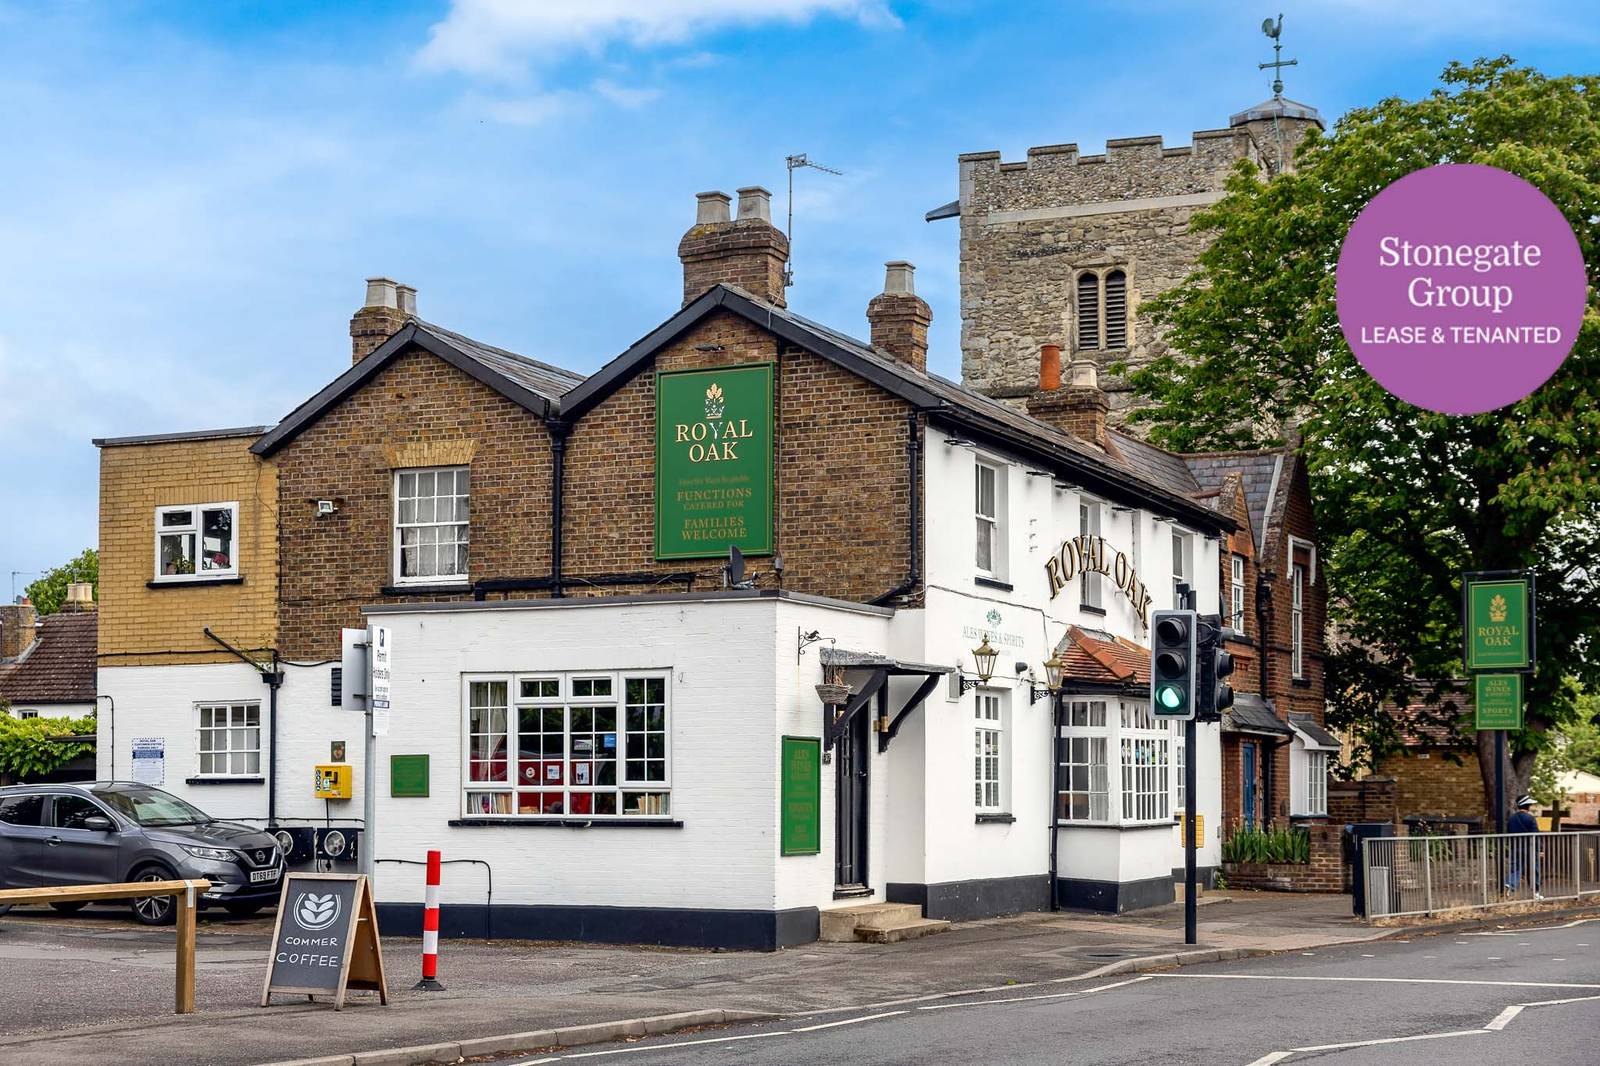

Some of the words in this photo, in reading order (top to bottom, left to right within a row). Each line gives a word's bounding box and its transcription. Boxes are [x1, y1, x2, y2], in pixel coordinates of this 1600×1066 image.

[675, 419, 753, 442] ROYAL
[689, 441, 738, 462] OAK
[677, 488, 752, 502] FUNCTIONS
[684, 516, 744, 529] FAMILIES
[682, 527, 747, 540] WELCOME
[1045, 534, 1110, 600] ROYAL
[1114, 551, 1152, 630] OAK
[1478, 625, 1520, 637] ROYAL
[1484, 636, 1511, 646] OAK
[285, 937, 338, 946] COMMER
[276, 952, 338, 967] COFFEE
